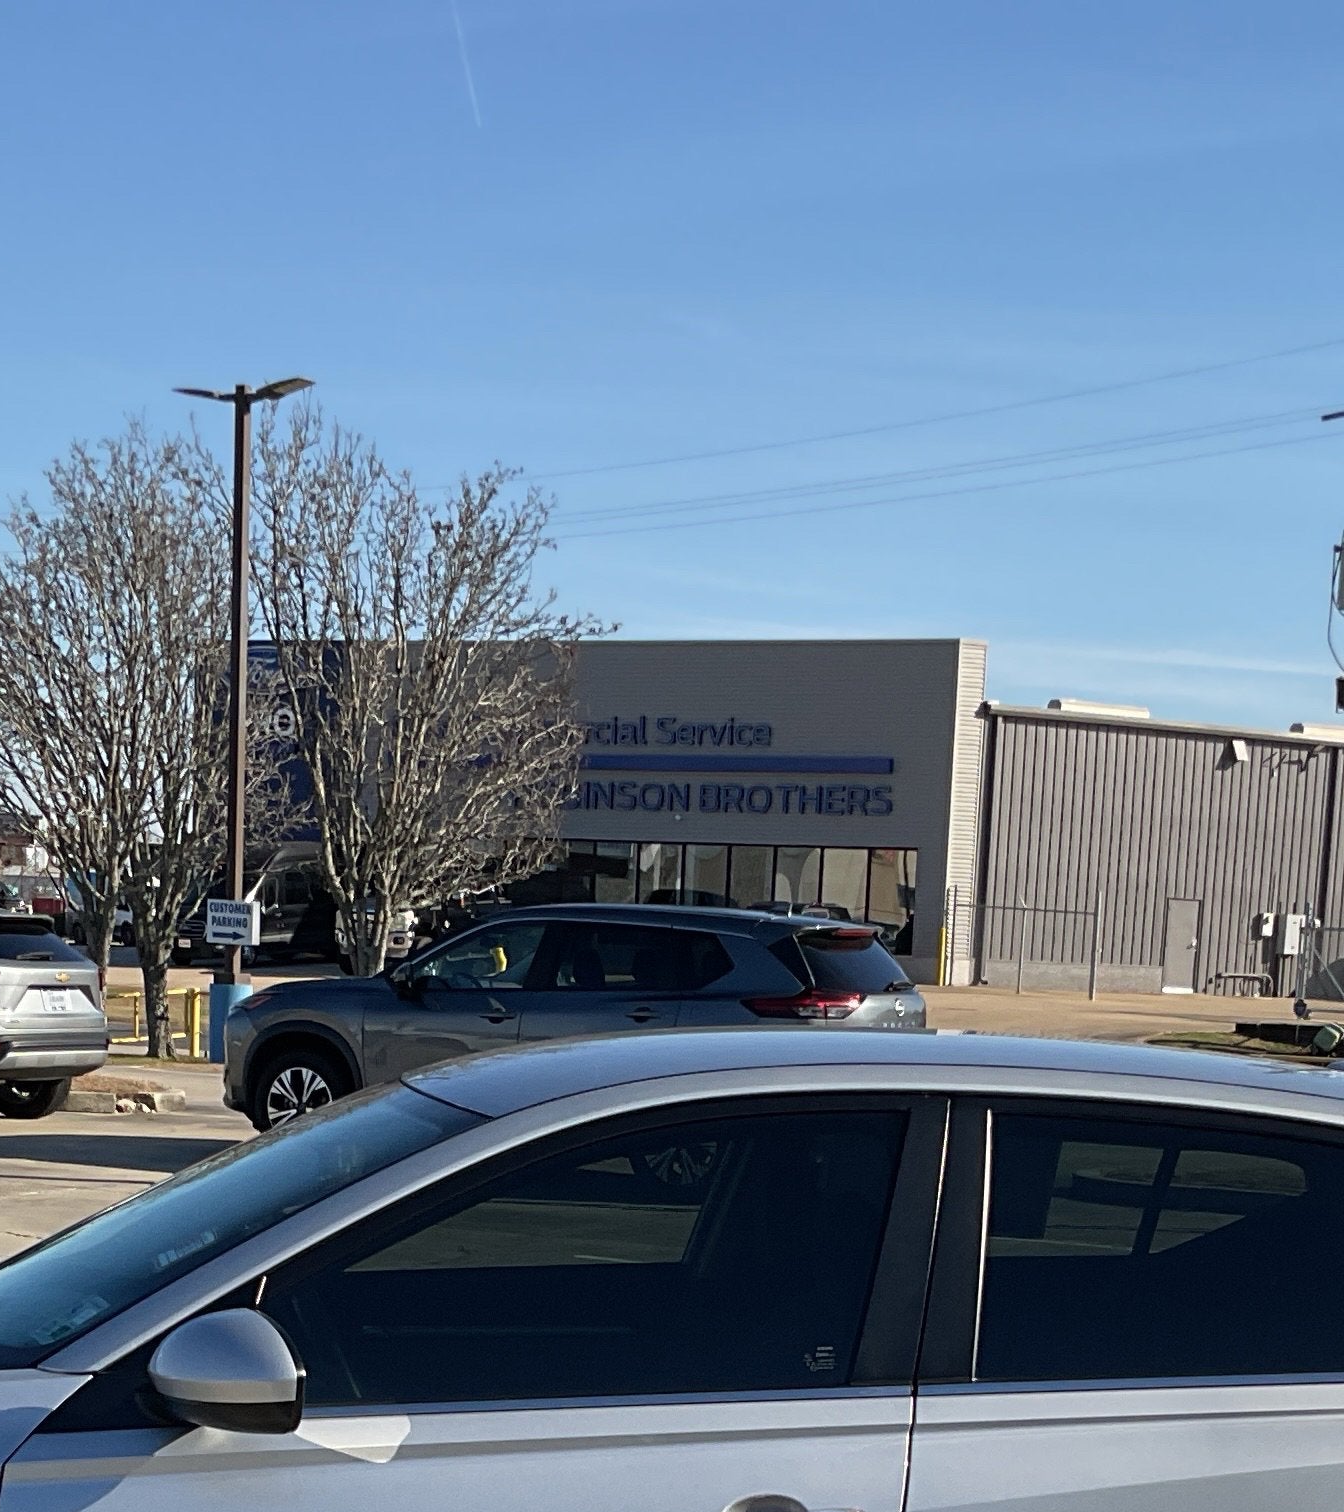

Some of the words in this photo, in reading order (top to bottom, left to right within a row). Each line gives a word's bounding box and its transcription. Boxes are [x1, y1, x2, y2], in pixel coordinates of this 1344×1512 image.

[656, 716, 773, 747] Service
[698, 783, 895, 817] BROTHERS
[209, 902, 252, 915] CUSTOMER
[211, 915, 248, 928] PARKING
